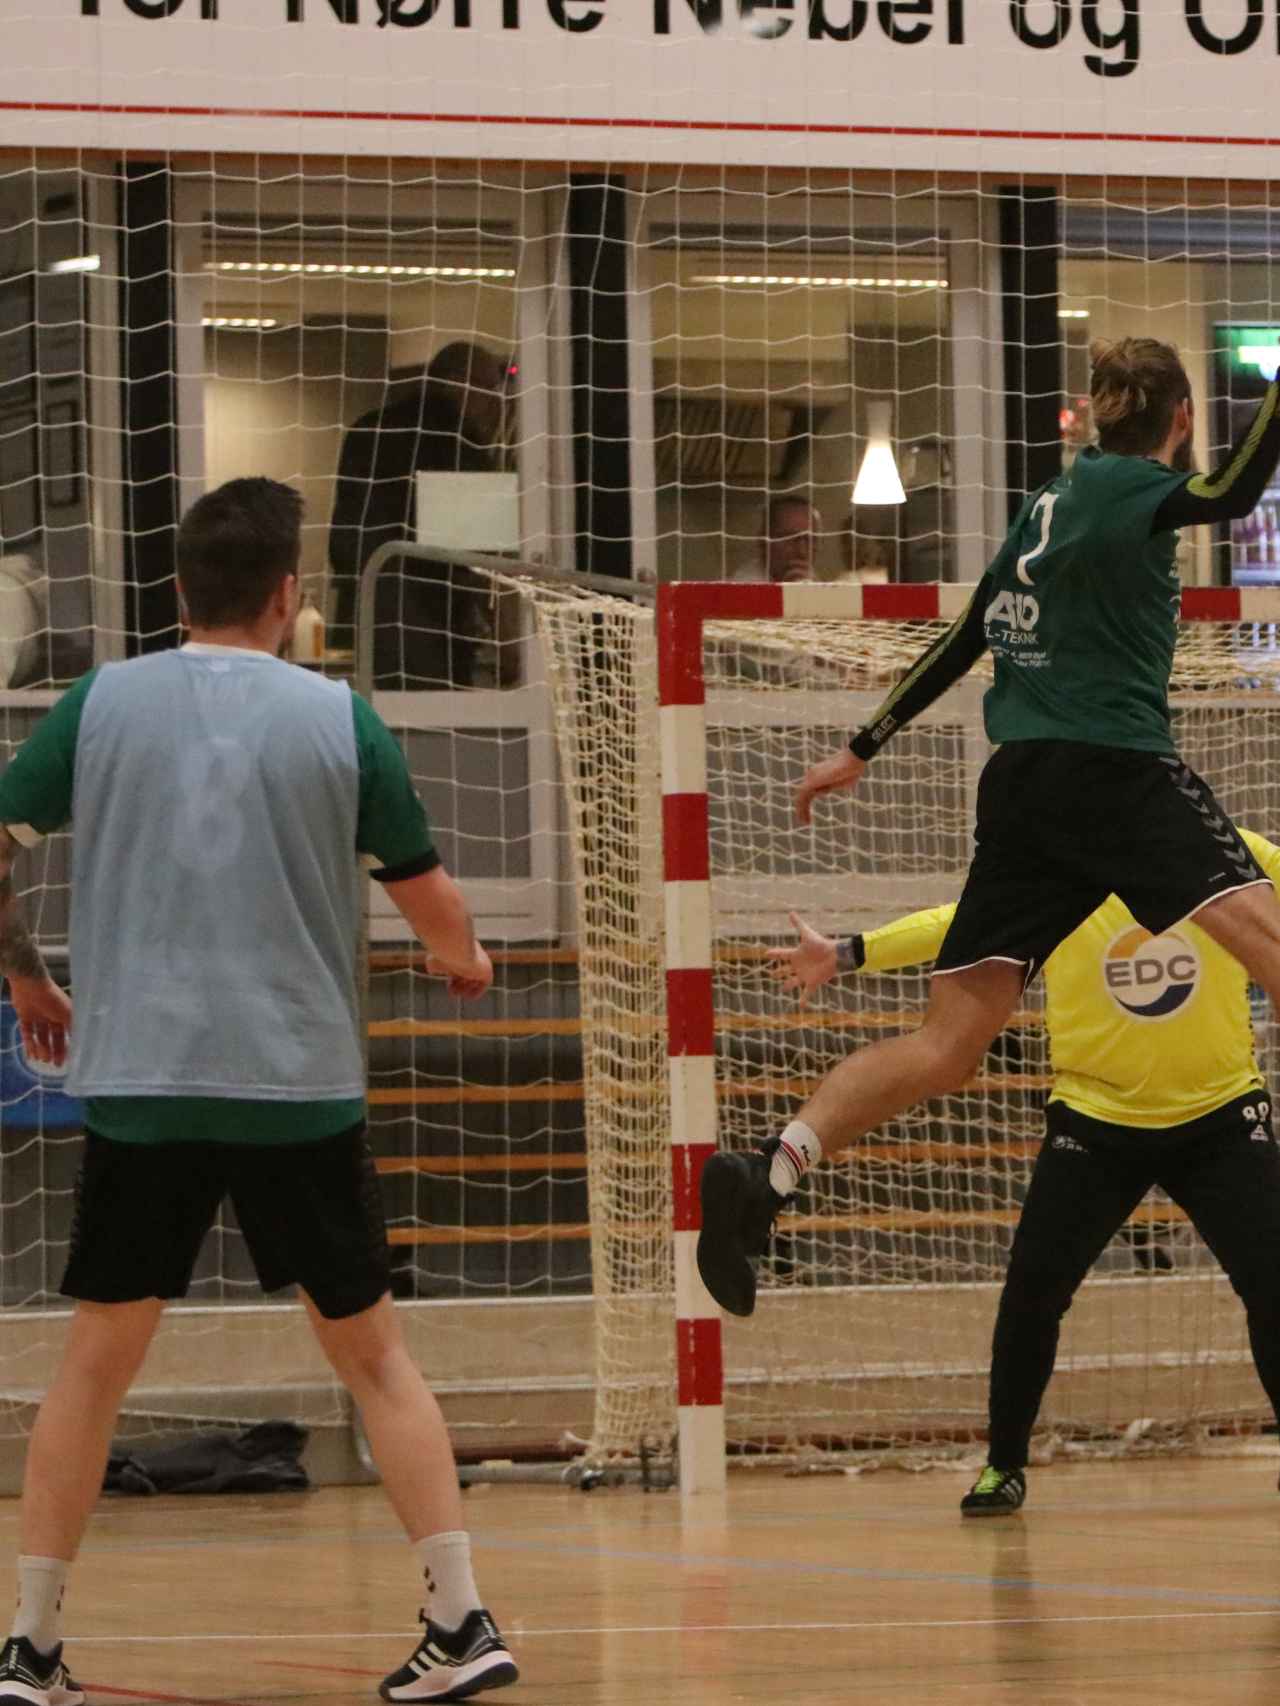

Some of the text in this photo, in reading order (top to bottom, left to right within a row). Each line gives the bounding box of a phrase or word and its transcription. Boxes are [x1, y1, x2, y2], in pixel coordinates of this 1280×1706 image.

[1009, 0, 1139, 77] og
[1016, 491, 1060, 586] 7
[1104, 954, 1197, 988] EDC
